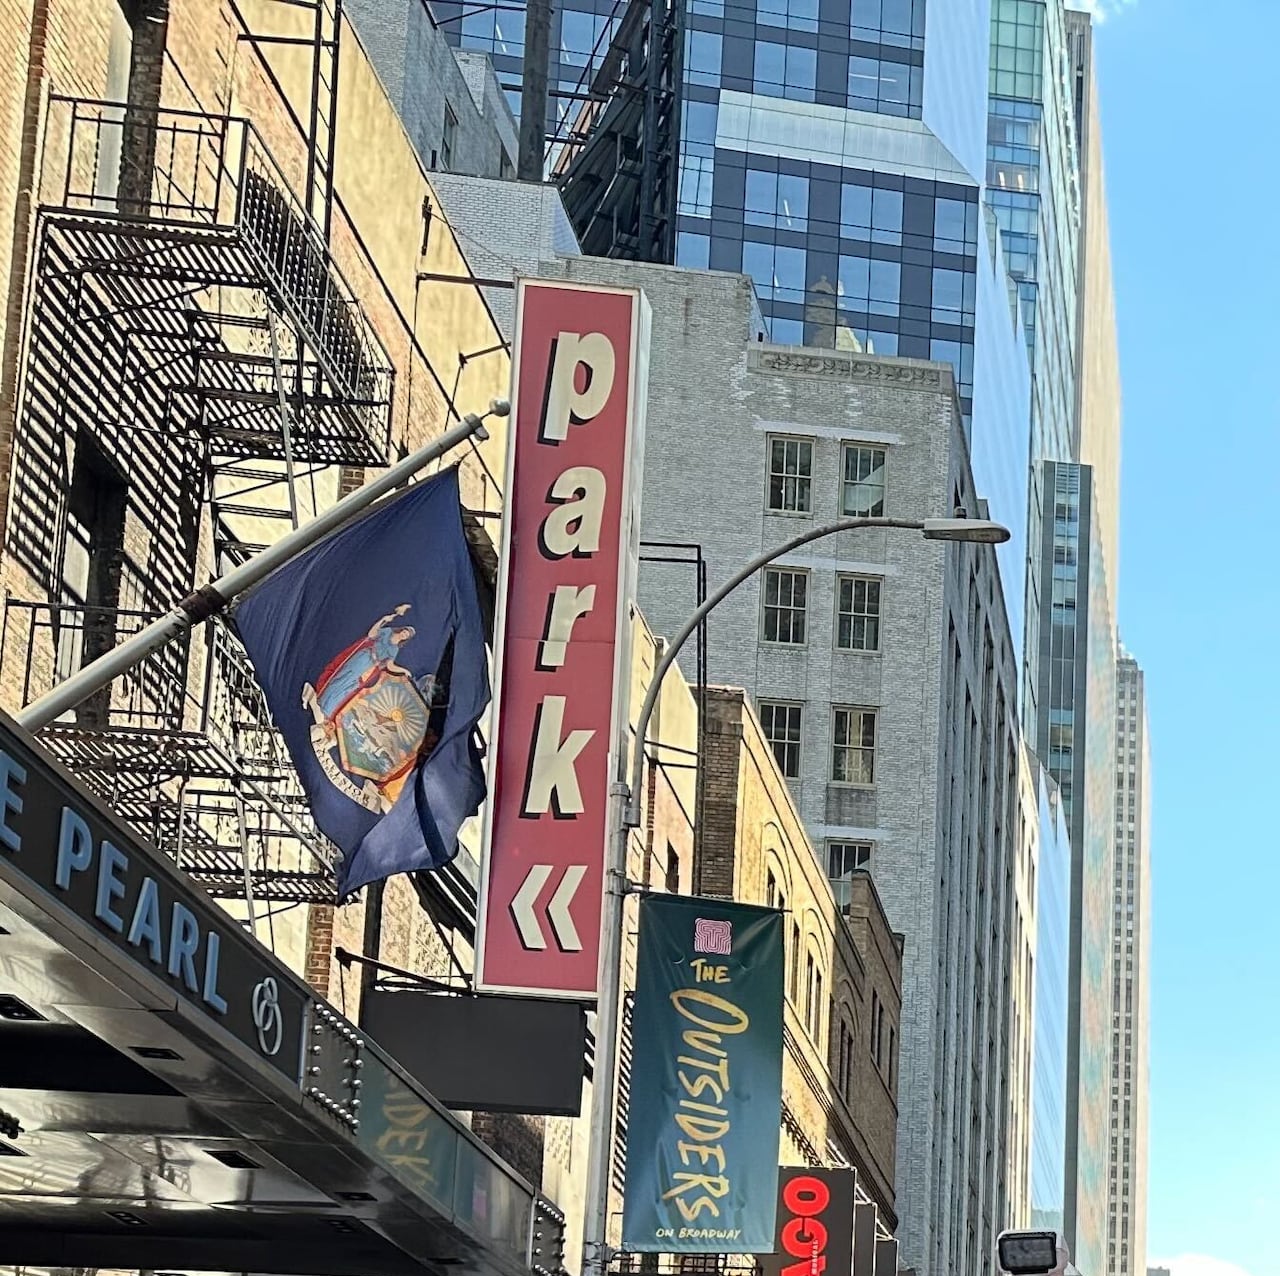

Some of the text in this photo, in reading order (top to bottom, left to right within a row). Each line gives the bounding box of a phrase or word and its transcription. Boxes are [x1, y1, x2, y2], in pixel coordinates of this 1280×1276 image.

[519, 329, 617, 819] park
[55, 806, 228, 1016] PEARL
[689, 957, 732, 984] THE
[662, 987, 750, 1223] OUTSIDERS
[655, 1226, 742, 1240] ON BROADWAY
